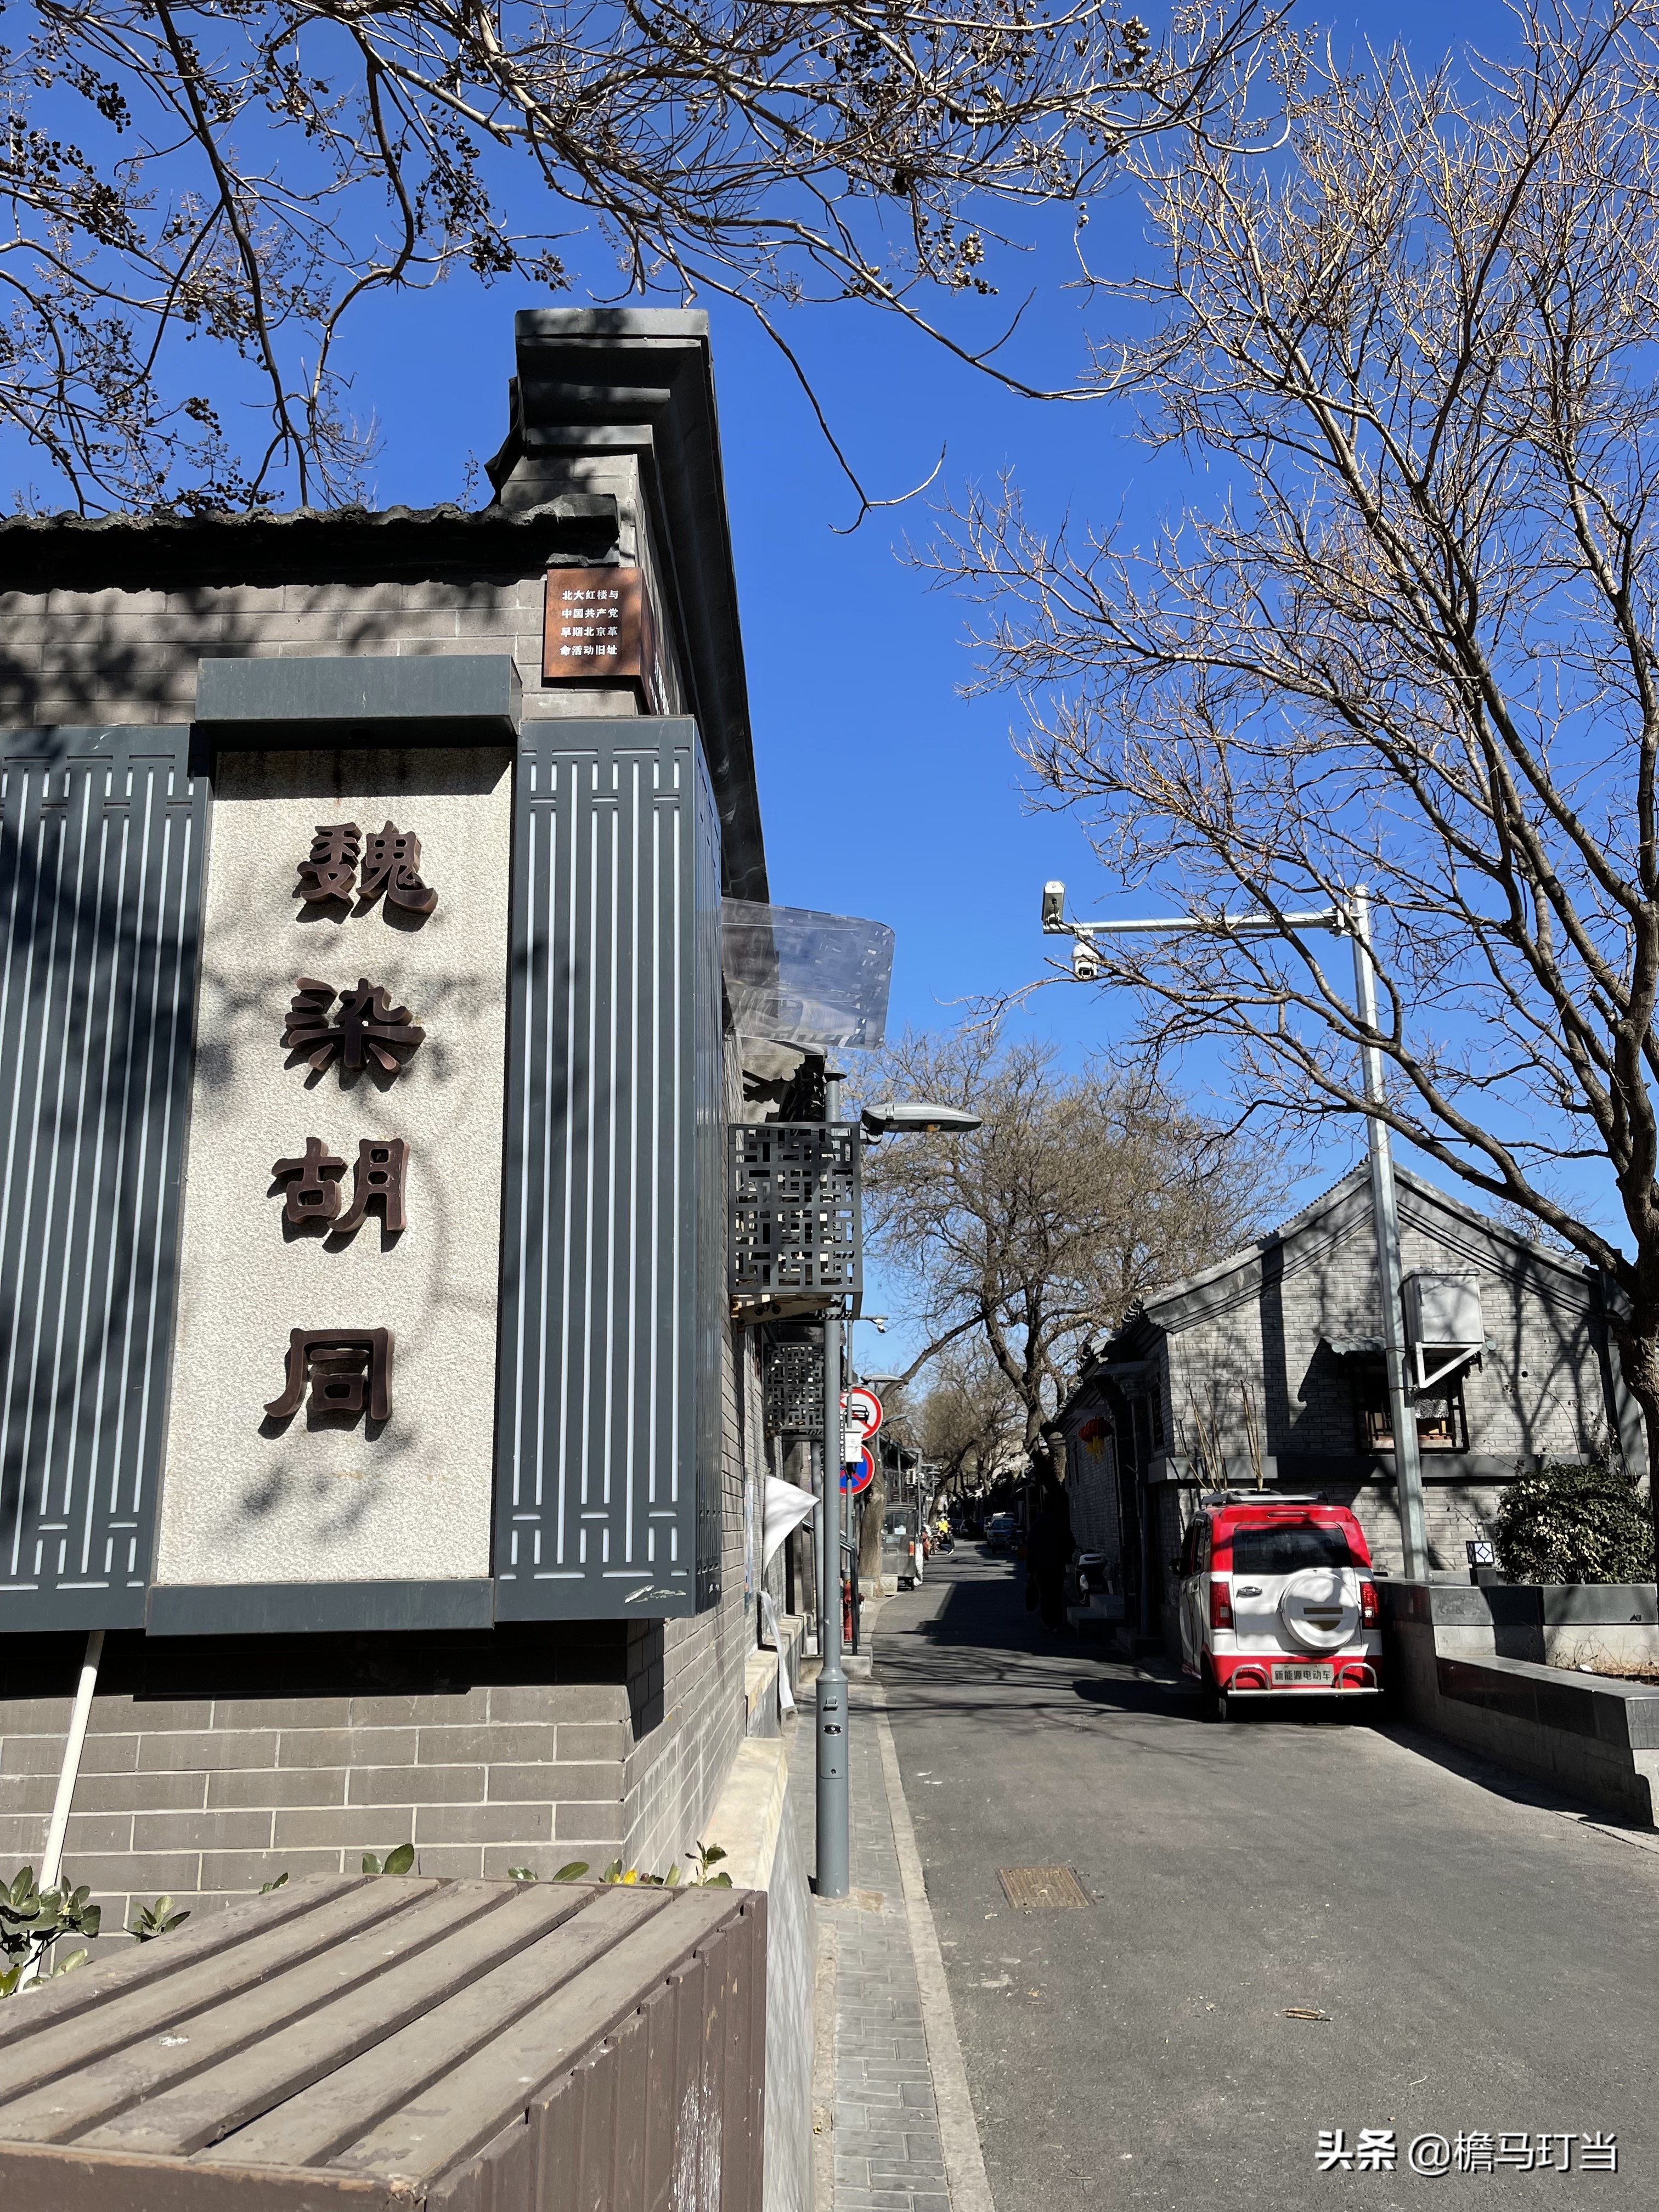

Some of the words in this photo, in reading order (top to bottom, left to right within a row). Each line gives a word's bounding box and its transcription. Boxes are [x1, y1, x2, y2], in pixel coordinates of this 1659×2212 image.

[562, 590, 619, 600] 北大红楼与
[561, 608, 618, 619] 中国共产党
[561, 627, 618, 637] 早期北京革
[560, 645, 618, 656] 命活动旧址
[263, 820, 438, 1421] 魏染胡同
[1274, 1670, 1331, 1680] 新能源电动车
